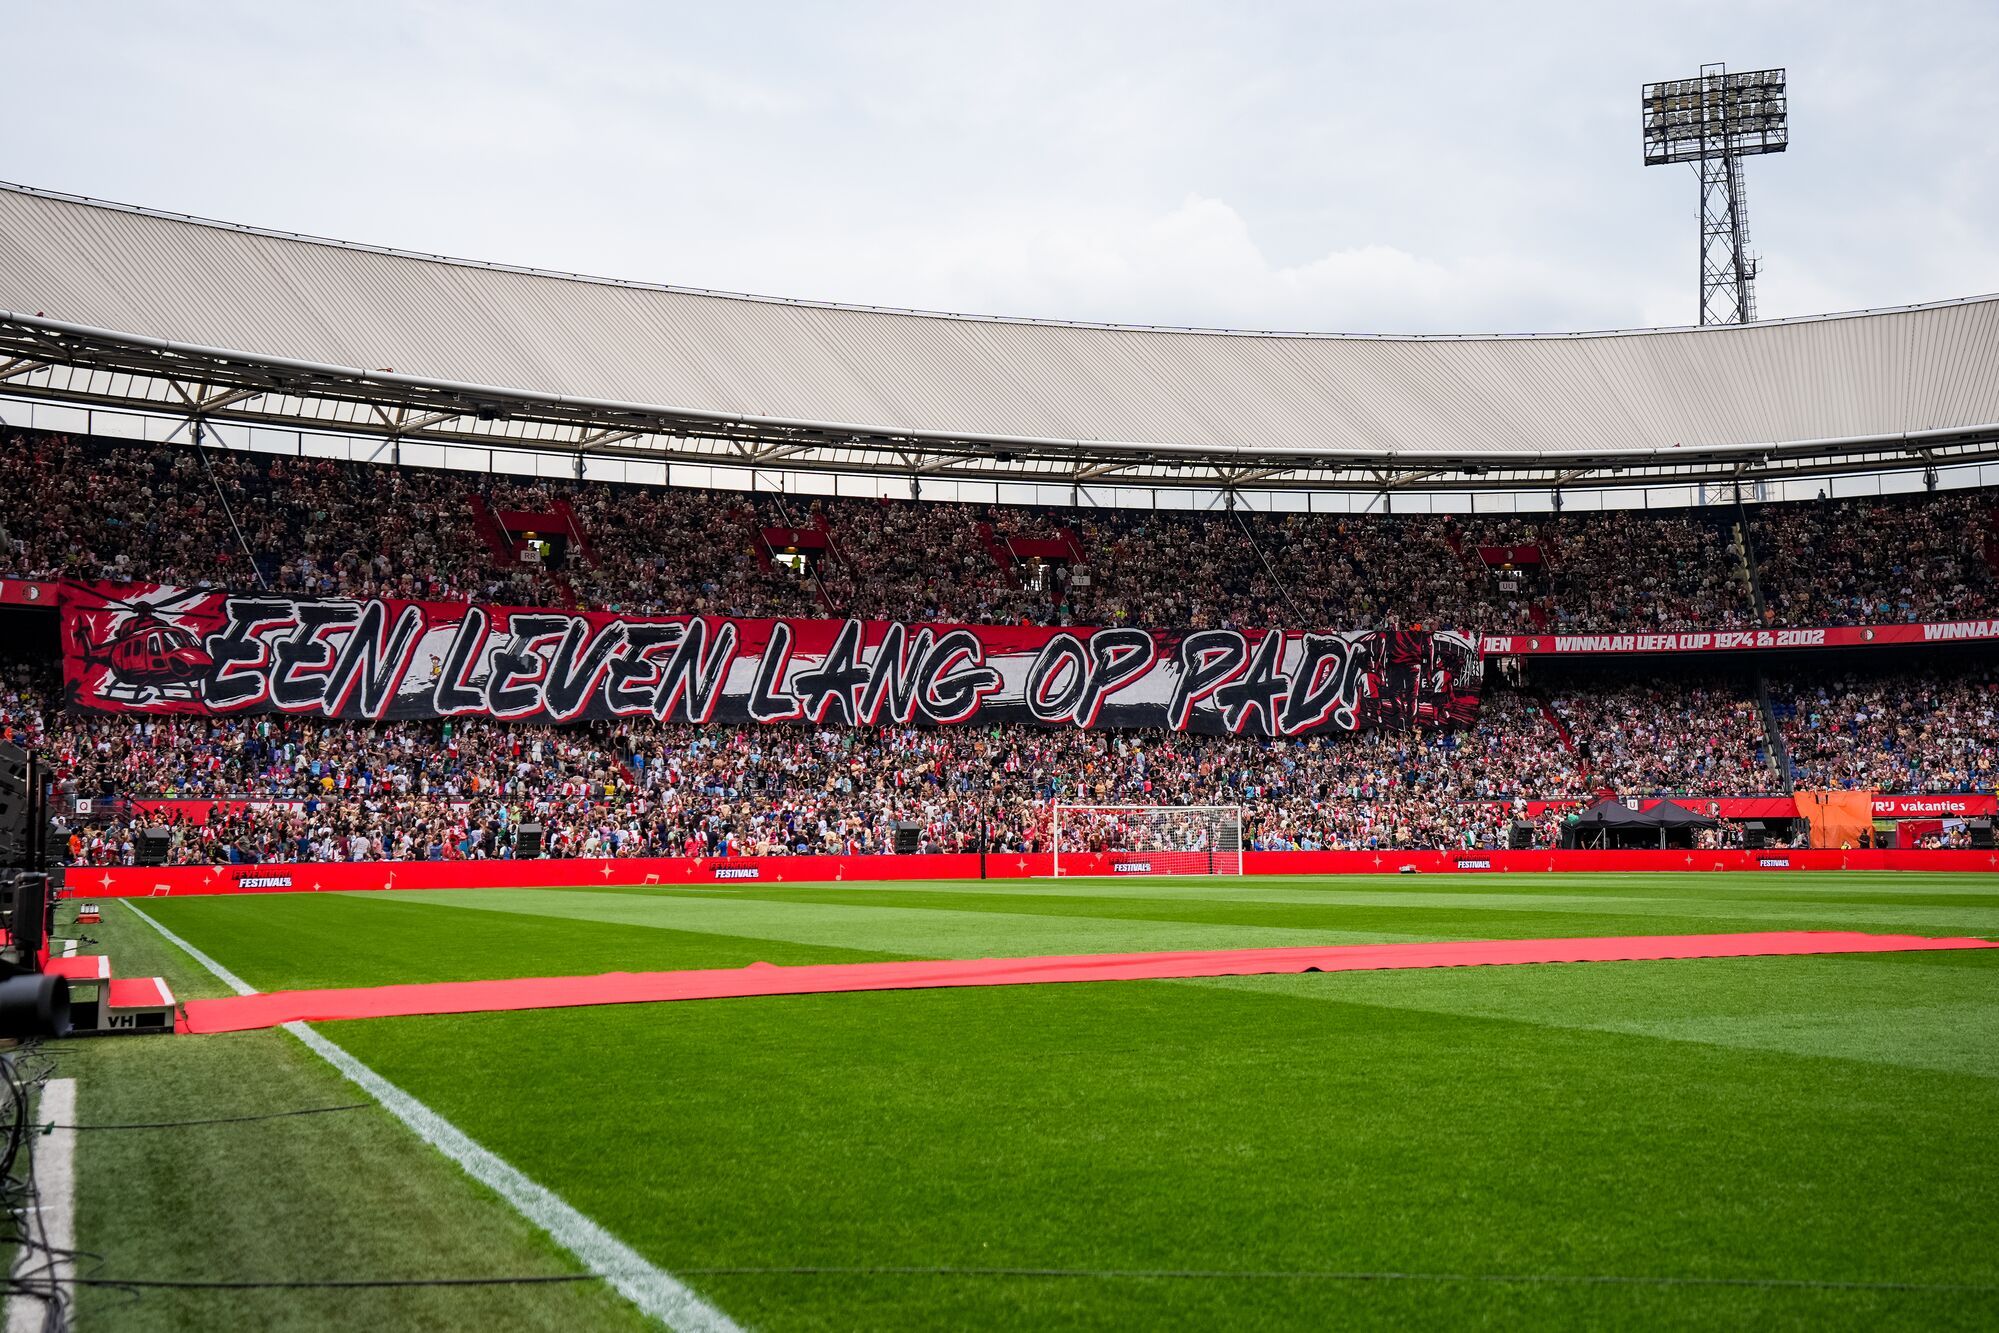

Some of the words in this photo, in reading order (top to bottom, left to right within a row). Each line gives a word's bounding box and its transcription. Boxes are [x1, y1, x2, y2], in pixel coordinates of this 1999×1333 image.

[524, 552, 536, 560] RR
[1502, 582, 1514, 590] UU
[1555, 636, 1635, 652] WINNAAR
[1637, 634, 1677, 650] UEFA
[1679, 633, 1710, 649] CUP
[1713, 632, 1753, 648] 1974
[1757, 631, 1774, 646] &
[1777, 629, 1825, 645] 2002
[203, 597, 423, 719] EEN
[433, 607, 738, 724] LEVEN
[748, 618, 1003, 727] LANG
[1025, 628, 1157, 730] OP
[1166, 630, 1366, 737] PAD!
[80, 801, 88, 811] Q
[1629, 801, 1636, 809] U
[1901, 801, 1966, 811] vakanties
[108, 1016, 133, 1027] VH
